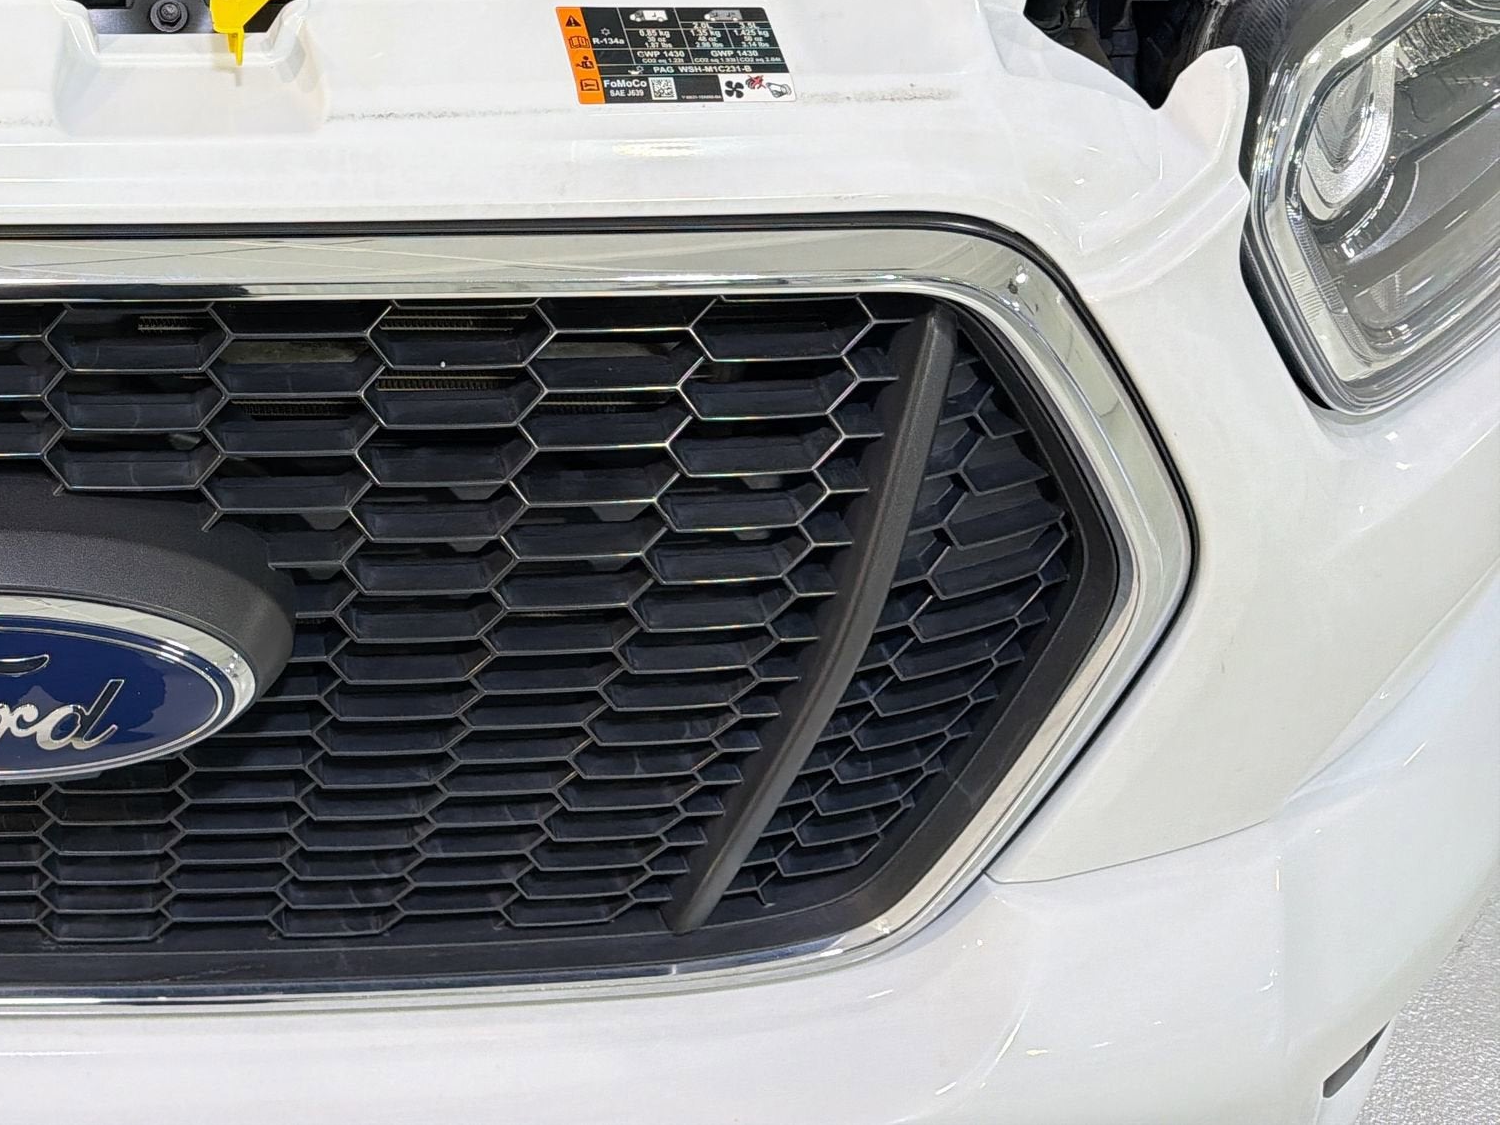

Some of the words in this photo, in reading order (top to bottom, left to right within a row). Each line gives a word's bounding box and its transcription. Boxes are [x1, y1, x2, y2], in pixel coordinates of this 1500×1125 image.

[658, 30, 671, 38] kg
[592, 37, 625, 45] R-134a
[663, 50, 685, 58] 1430
[653, 66, 675, 74] PAG
[679, 65, 753, 74] WSH-M1C231-B
[603, 78, 648, 88] FoMoCo
[609, 89, 625, 97] SAE
[626, 89, 645, 97] J639
